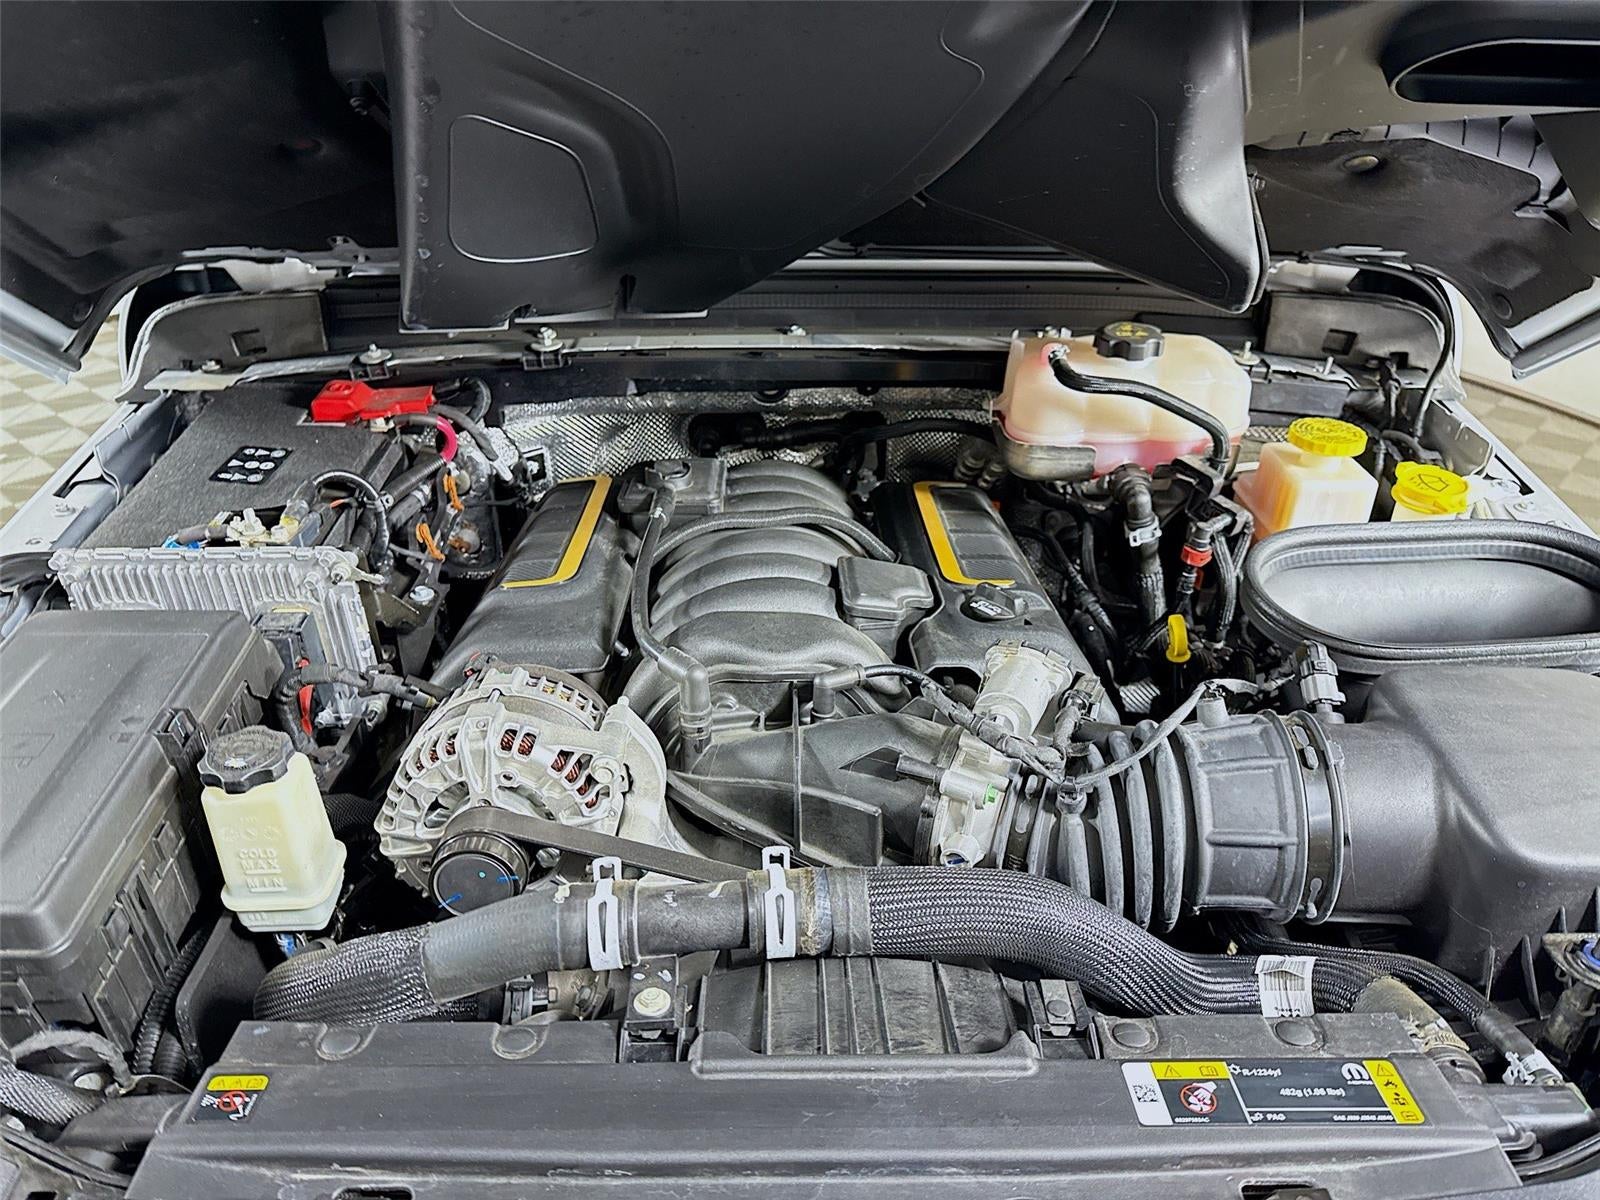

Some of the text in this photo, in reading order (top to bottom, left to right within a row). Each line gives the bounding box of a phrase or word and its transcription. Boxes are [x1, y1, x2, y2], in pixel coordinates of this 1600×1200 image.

[239, 848, 277, 859] COLD
[241, 859, 280, 871] MAX
[246, 877, 285, 889] MIN
